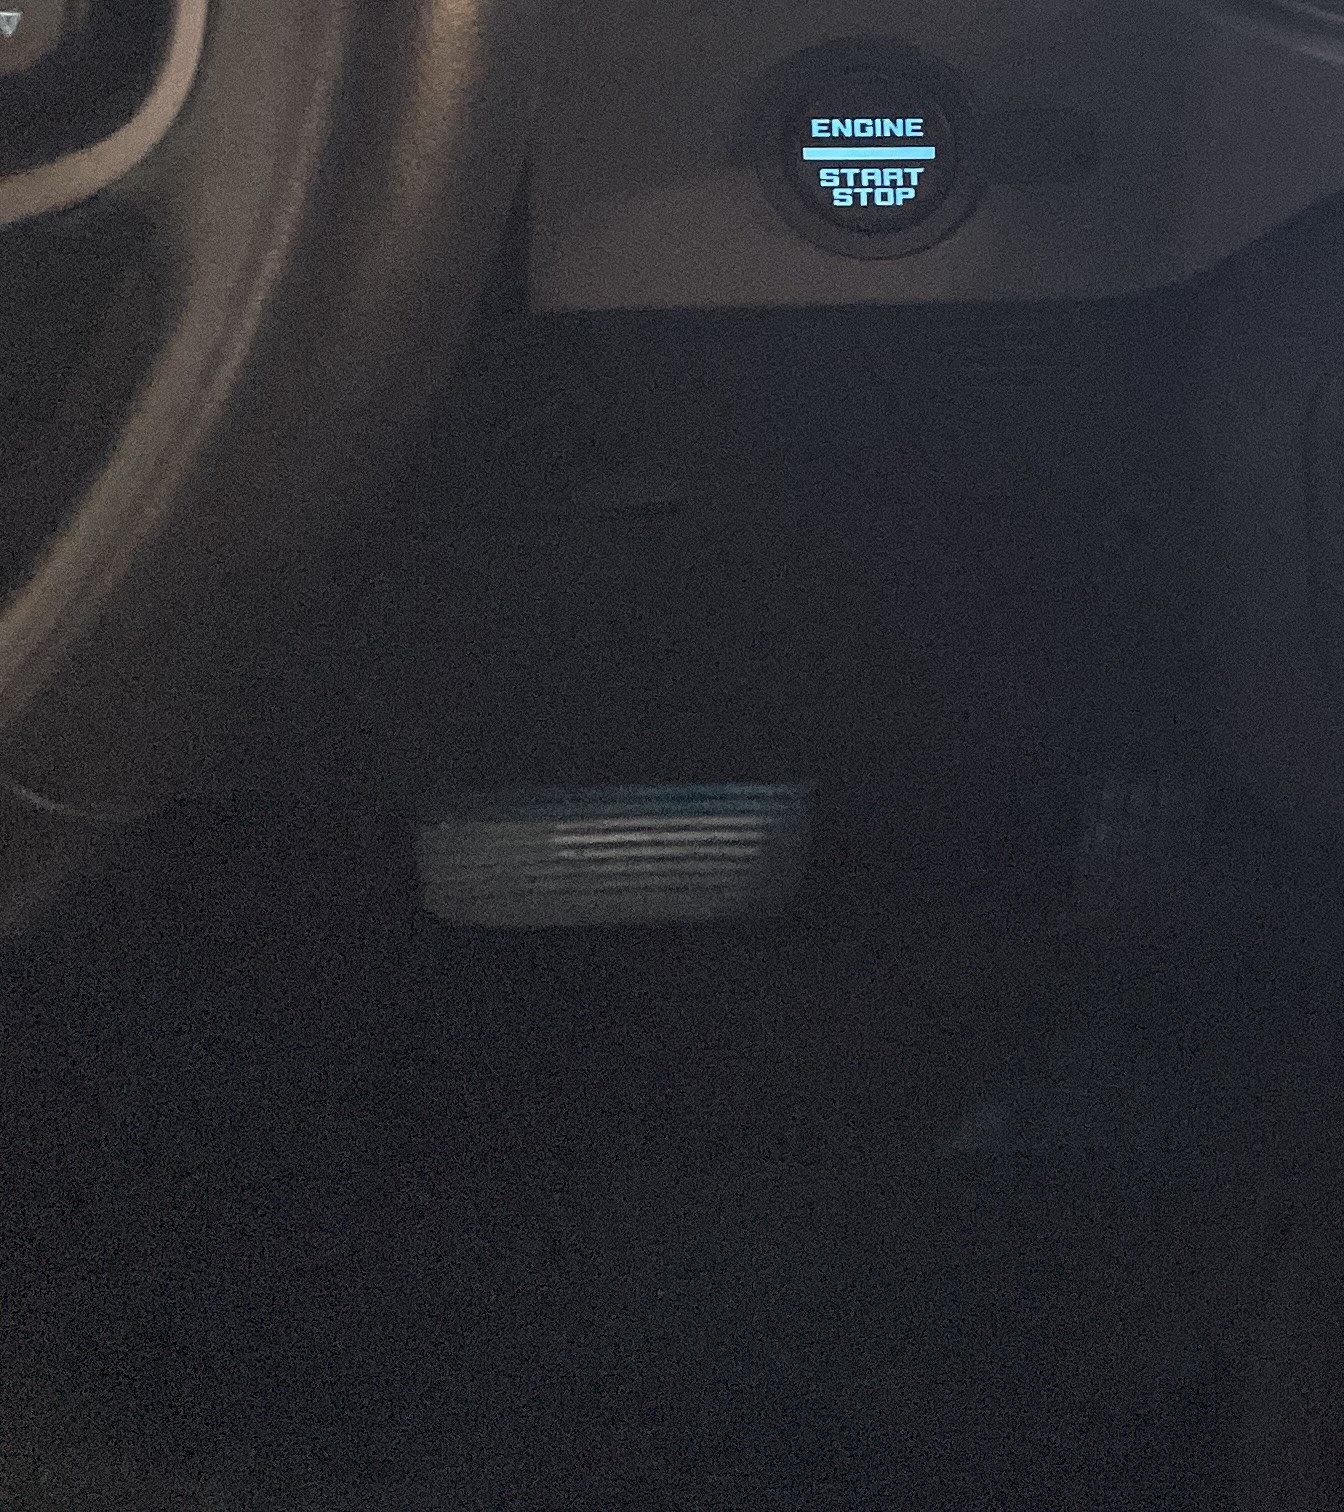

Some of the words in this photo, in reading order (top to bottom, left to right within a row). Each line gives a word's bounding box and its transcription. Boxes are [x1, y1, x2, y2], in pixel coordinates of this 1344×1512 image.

[811, 118, 924, 138] ENGINE
[819, 167, 925, 187] START
[832, 187, 916, 206] STOP
